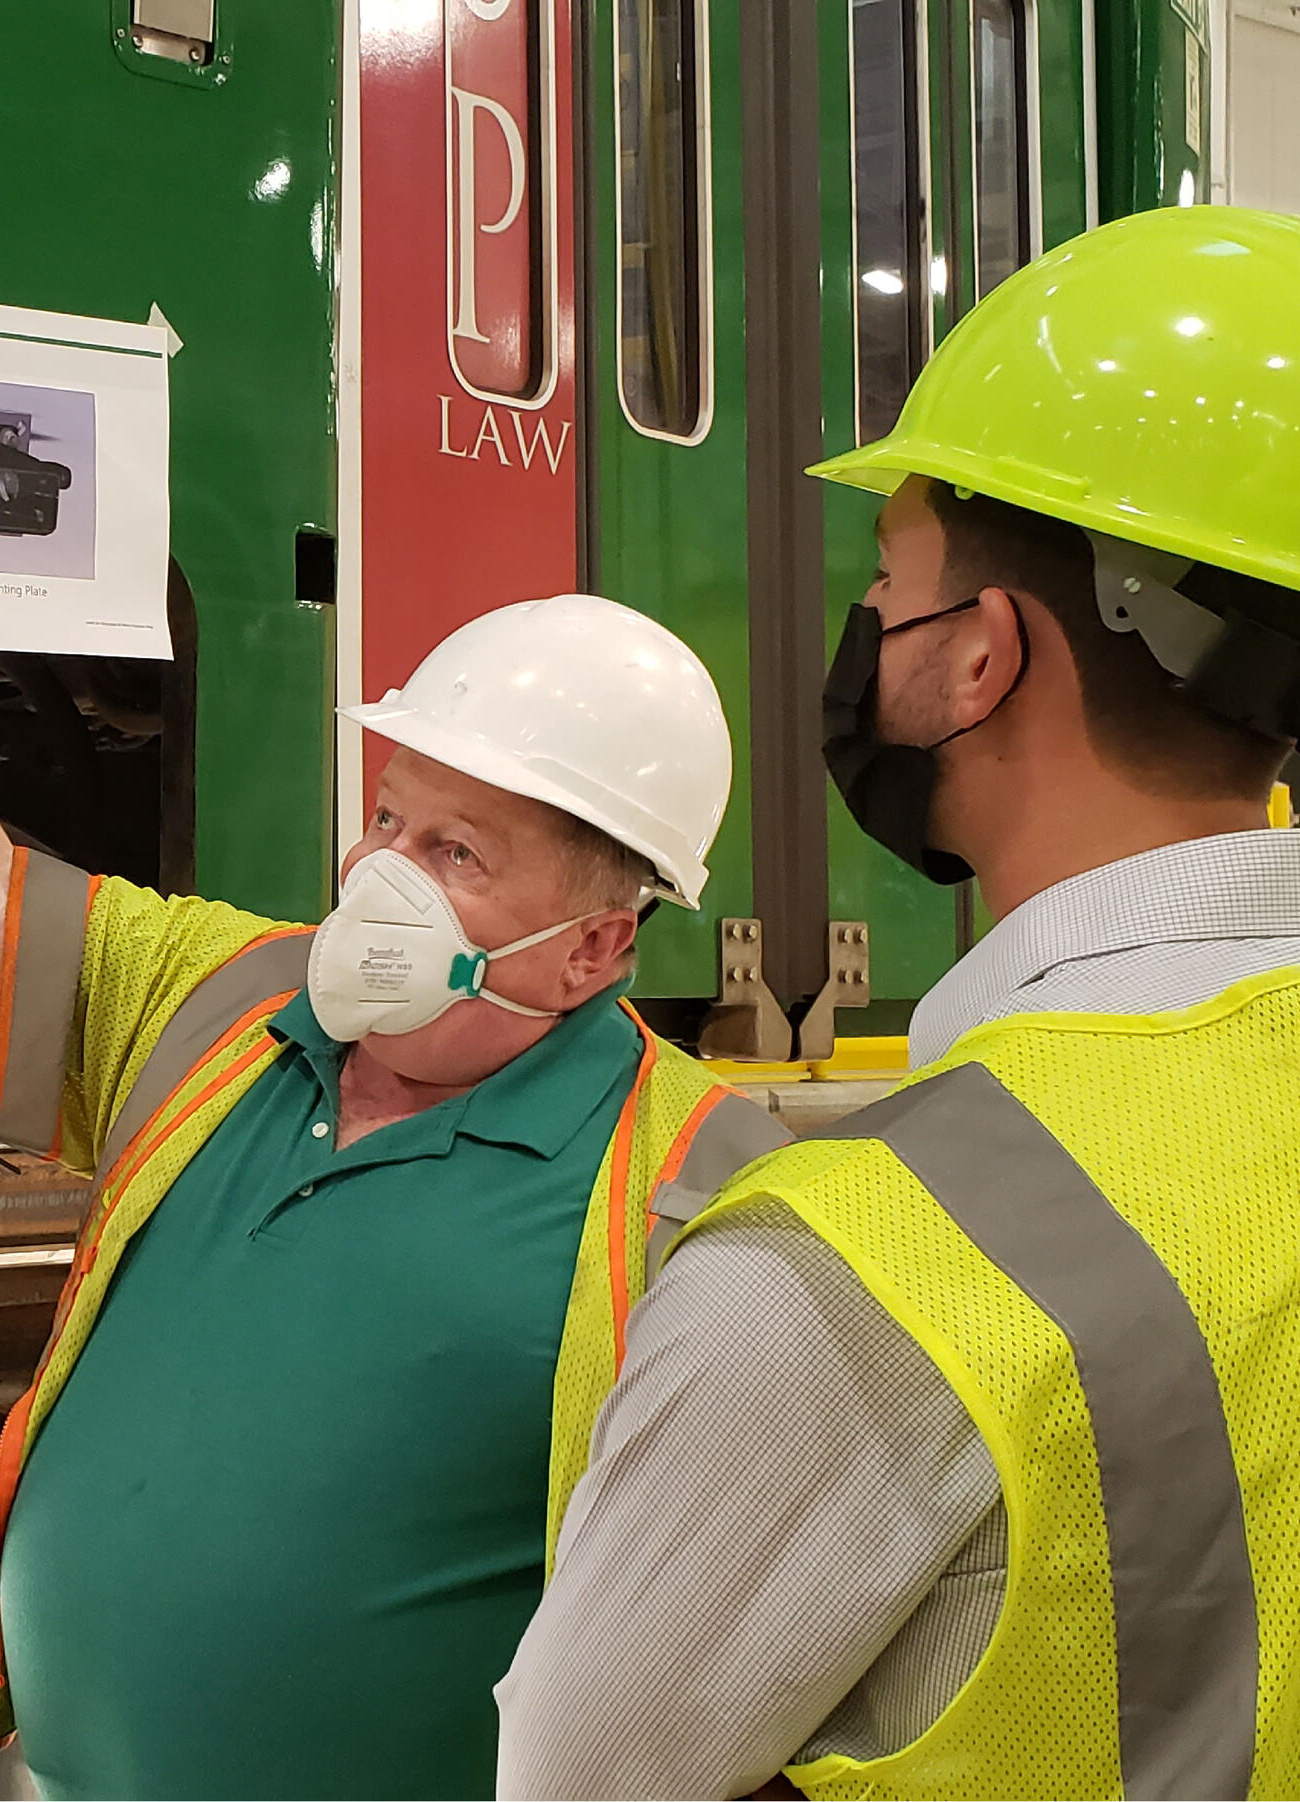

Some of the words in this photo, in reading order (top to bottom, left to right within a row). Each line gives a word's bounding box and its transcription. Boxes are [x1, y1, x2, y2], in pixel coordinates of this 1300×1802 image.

[451, 86, 526, 344] P
[437, 394, 573, 476] LAW
[25, 585, 49, 598] Plate
